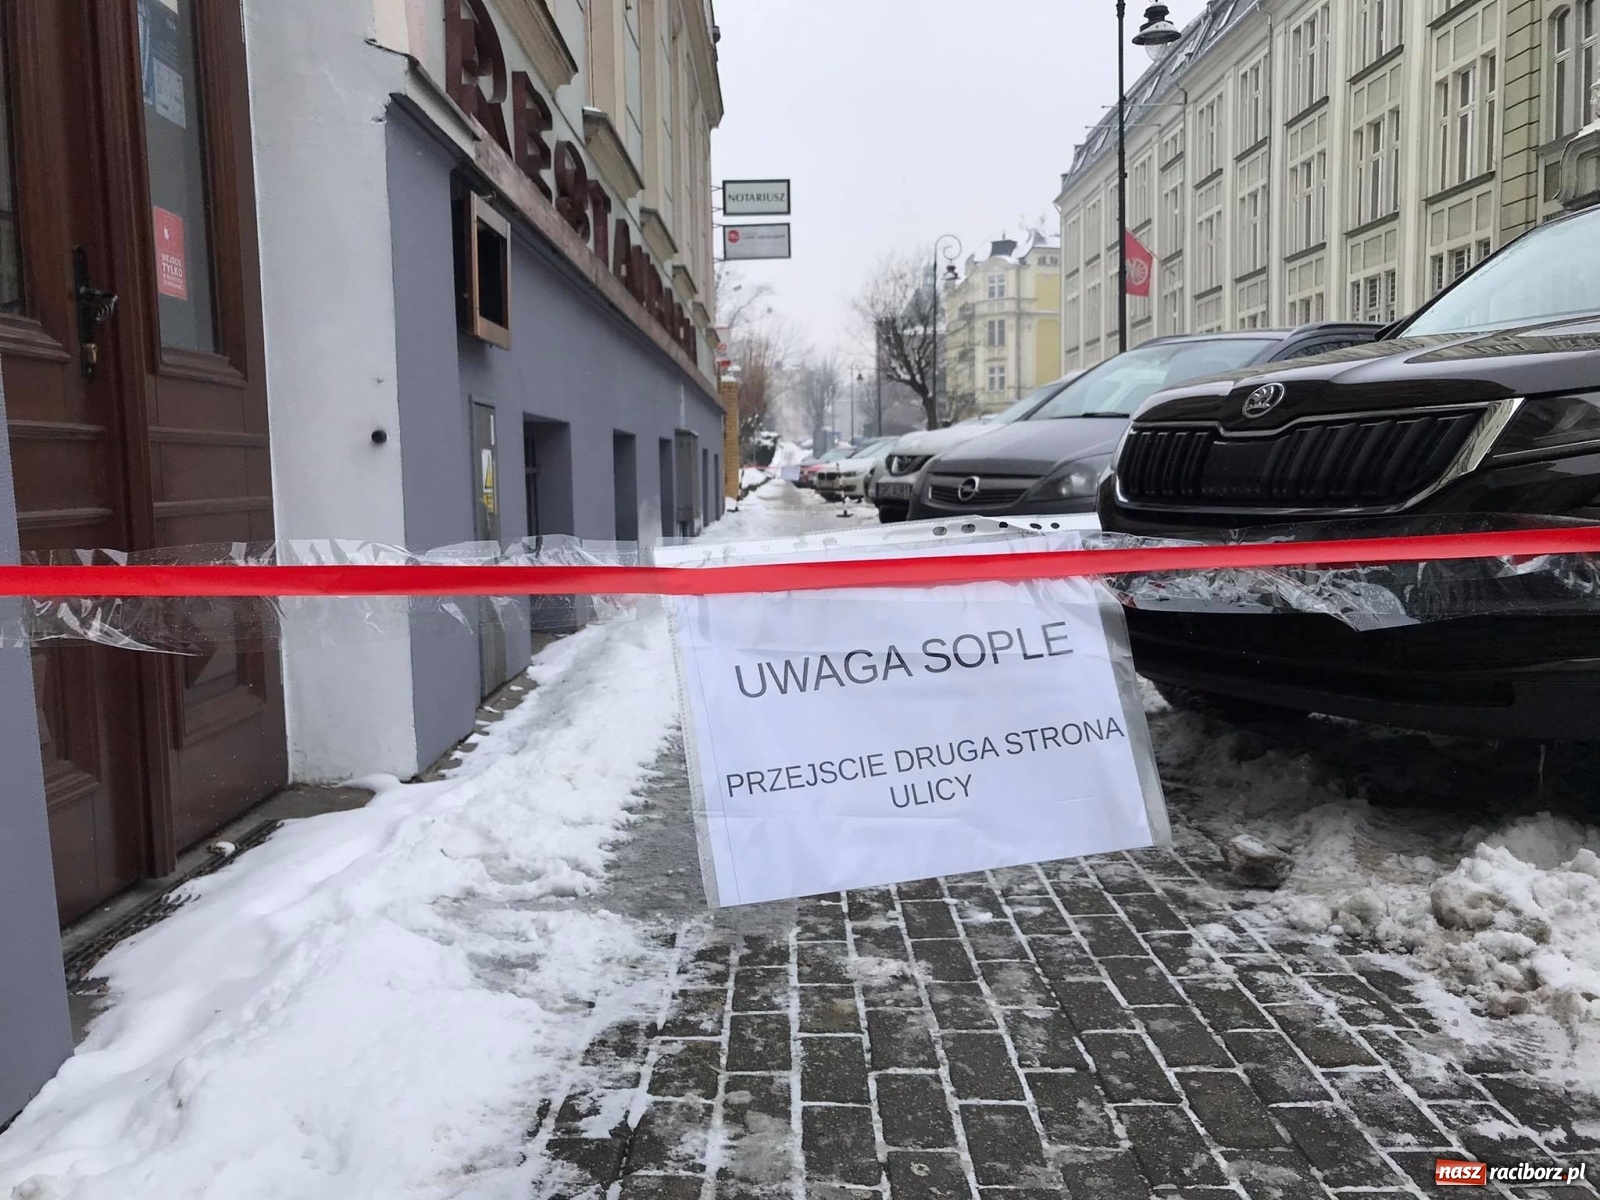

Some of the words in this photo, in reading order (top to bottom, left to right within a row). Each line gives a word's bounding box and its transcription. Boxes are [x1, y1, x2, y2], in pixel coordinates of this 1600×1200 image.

[727, 193, 786, 202] NOTARIUSZ
[161, 262, 183, 277] TYLKO
[735, 645, 914, 699] UWAGA
[921, 621, 1074, 674] SOPLE
[726, 753, 888, 798] PRZEJSCIE
[893, 736, 1001, 773] DRUGA
[1004, 716, 1125, 755] STRONA
[889, 773, 973, 809] ULICY
